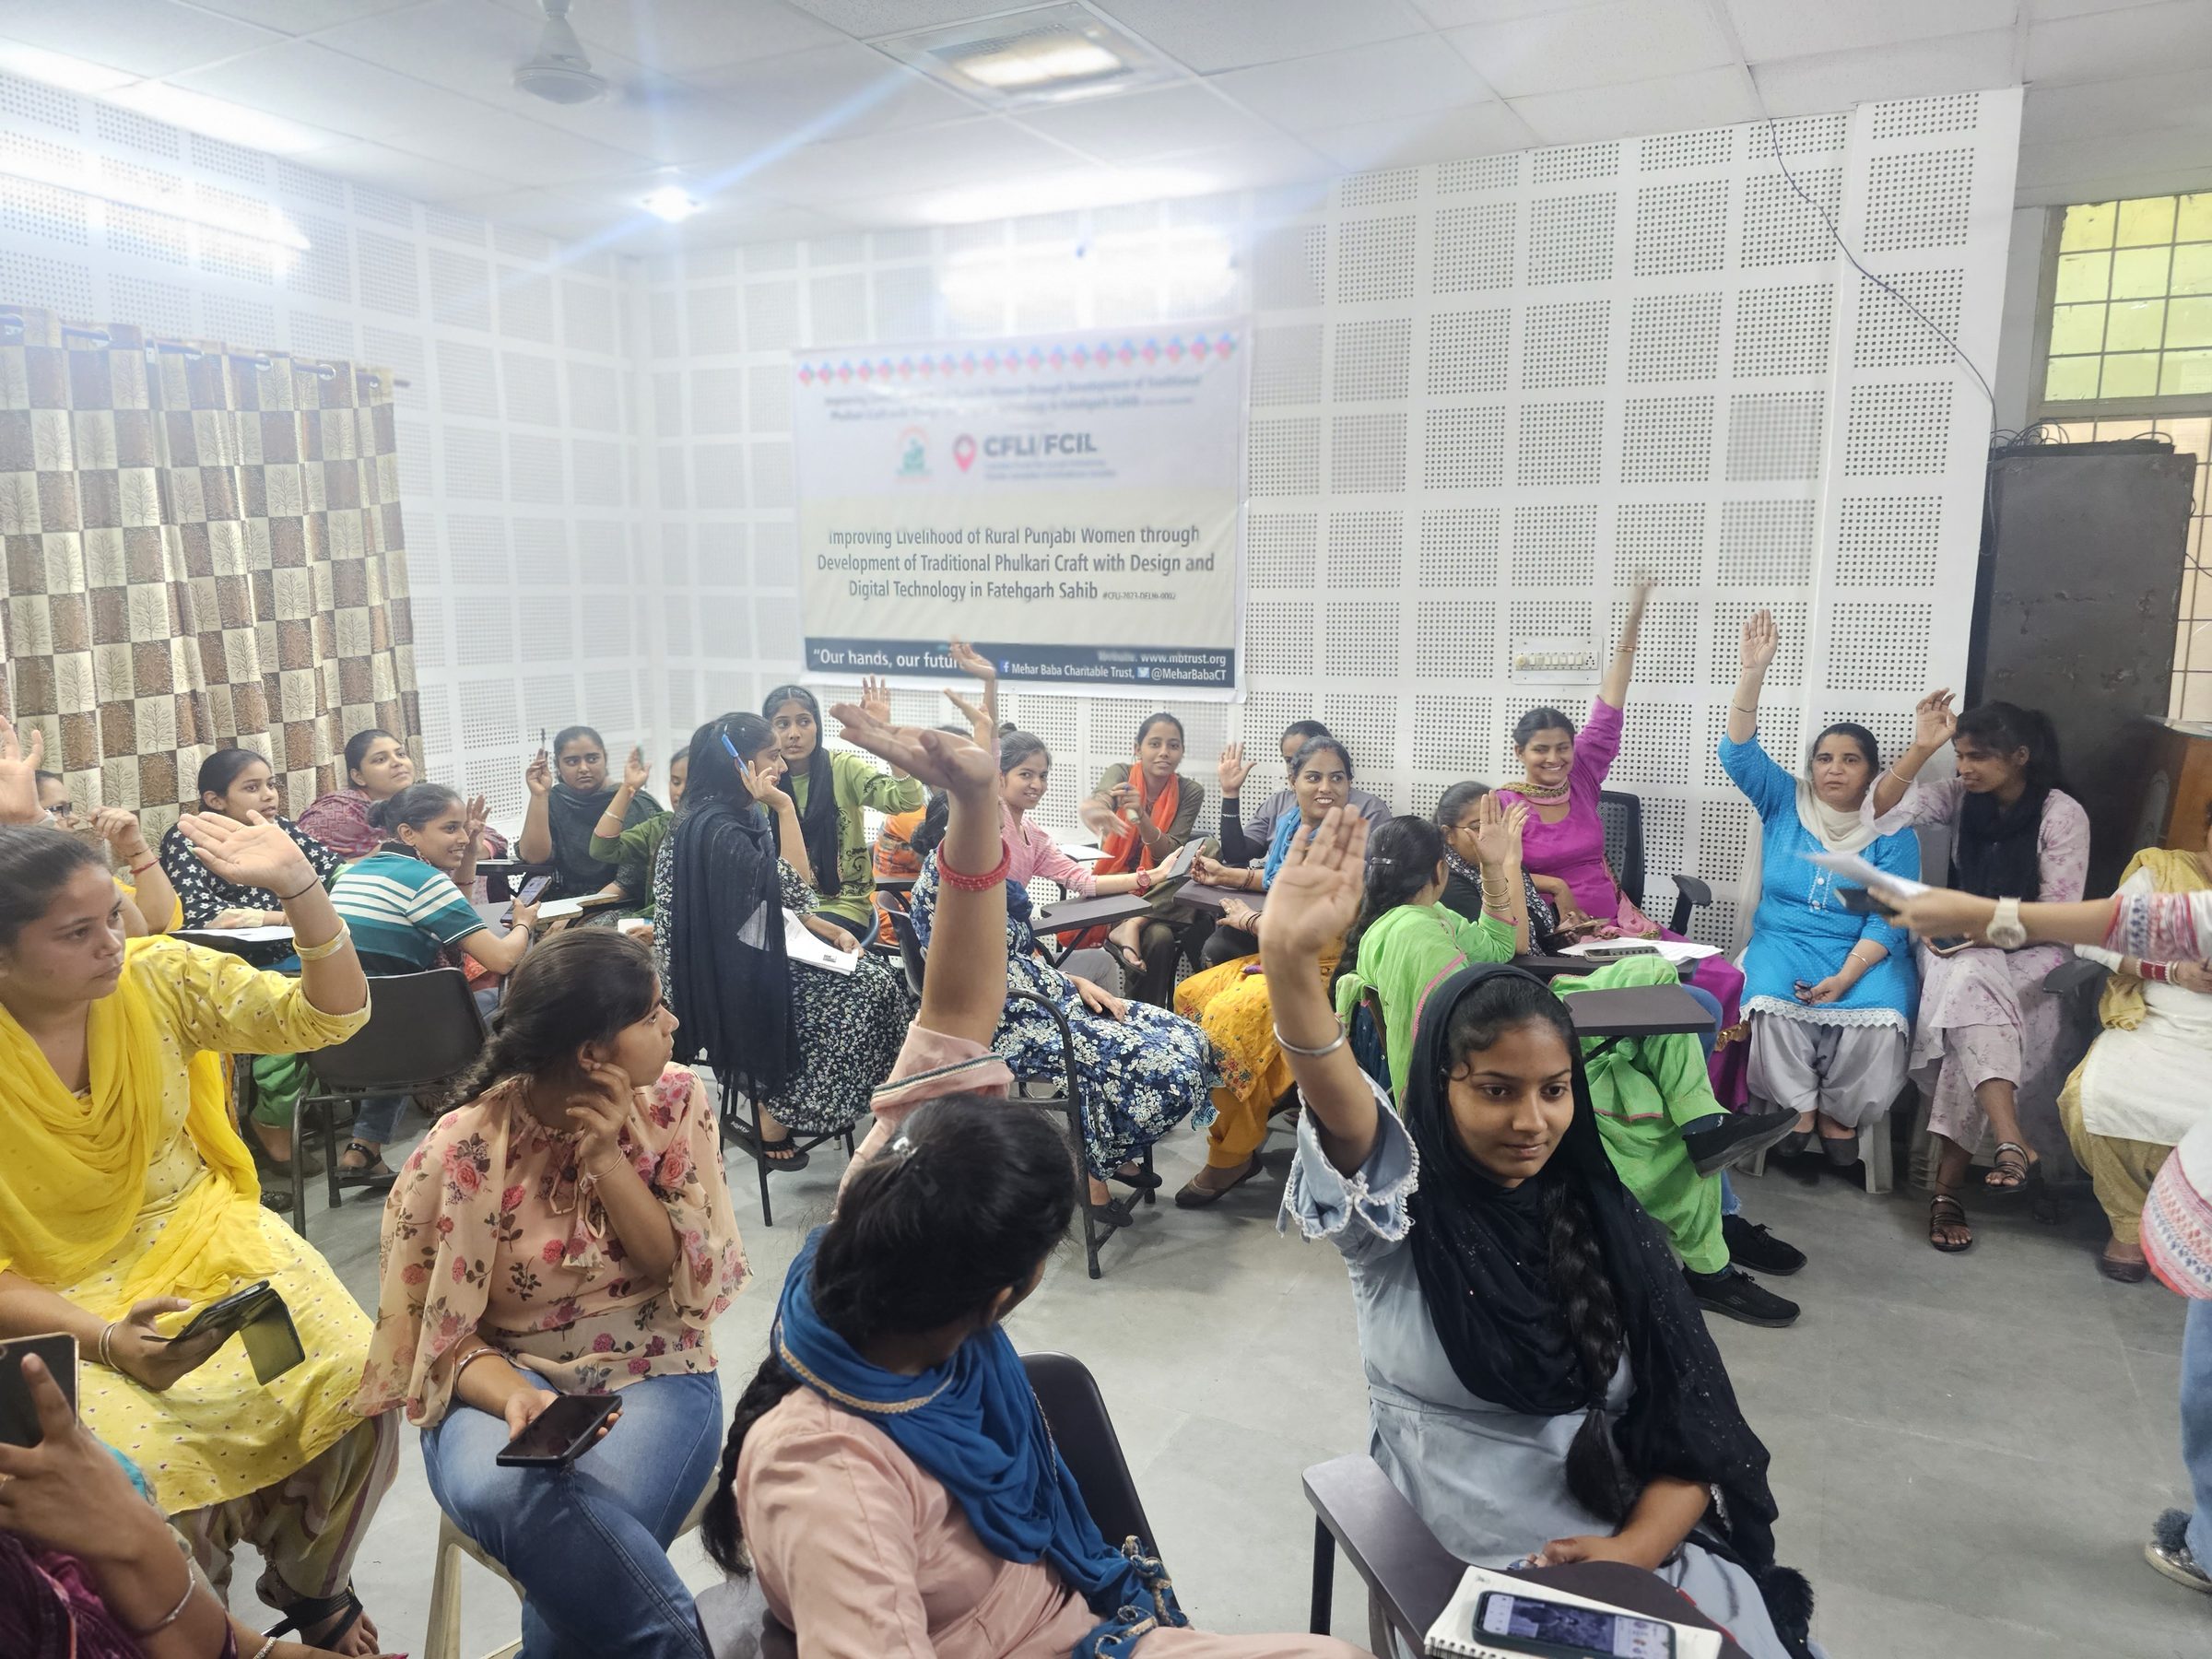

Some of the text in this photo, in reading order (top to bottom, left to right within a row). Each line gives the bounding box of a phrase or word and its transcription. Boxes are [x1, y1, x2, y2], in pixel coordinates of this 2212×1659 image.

[829, 525, 1200, 548] Improving Livelihood of Rural Punjabi Women through
[818, 553, 1215, 576] Development of Traditional Phulkari Craft with Design and
[849, 580, 889, 600] Digital
[893, 581, 966, 602] Technology
[971, 581, 982, 598] in
[987, 582, 1054, 602] Fatehgarh
[1059, 582, 1099, 599] Sahib
[848, 651, 892, 668] hands,
[896, 654, 920, 667] our
[1141, 652, 1227, 666] www.mbtrust.org
[1012, 663, 1039, 675] Mehar
[1041, 664, 1063, 676] Baba
[1064, 665, 1109, 677] Charitable
[1110, 666, 1135, 679] Trust,
[1151, 667, 1227, 681] @MeharBabaCT
